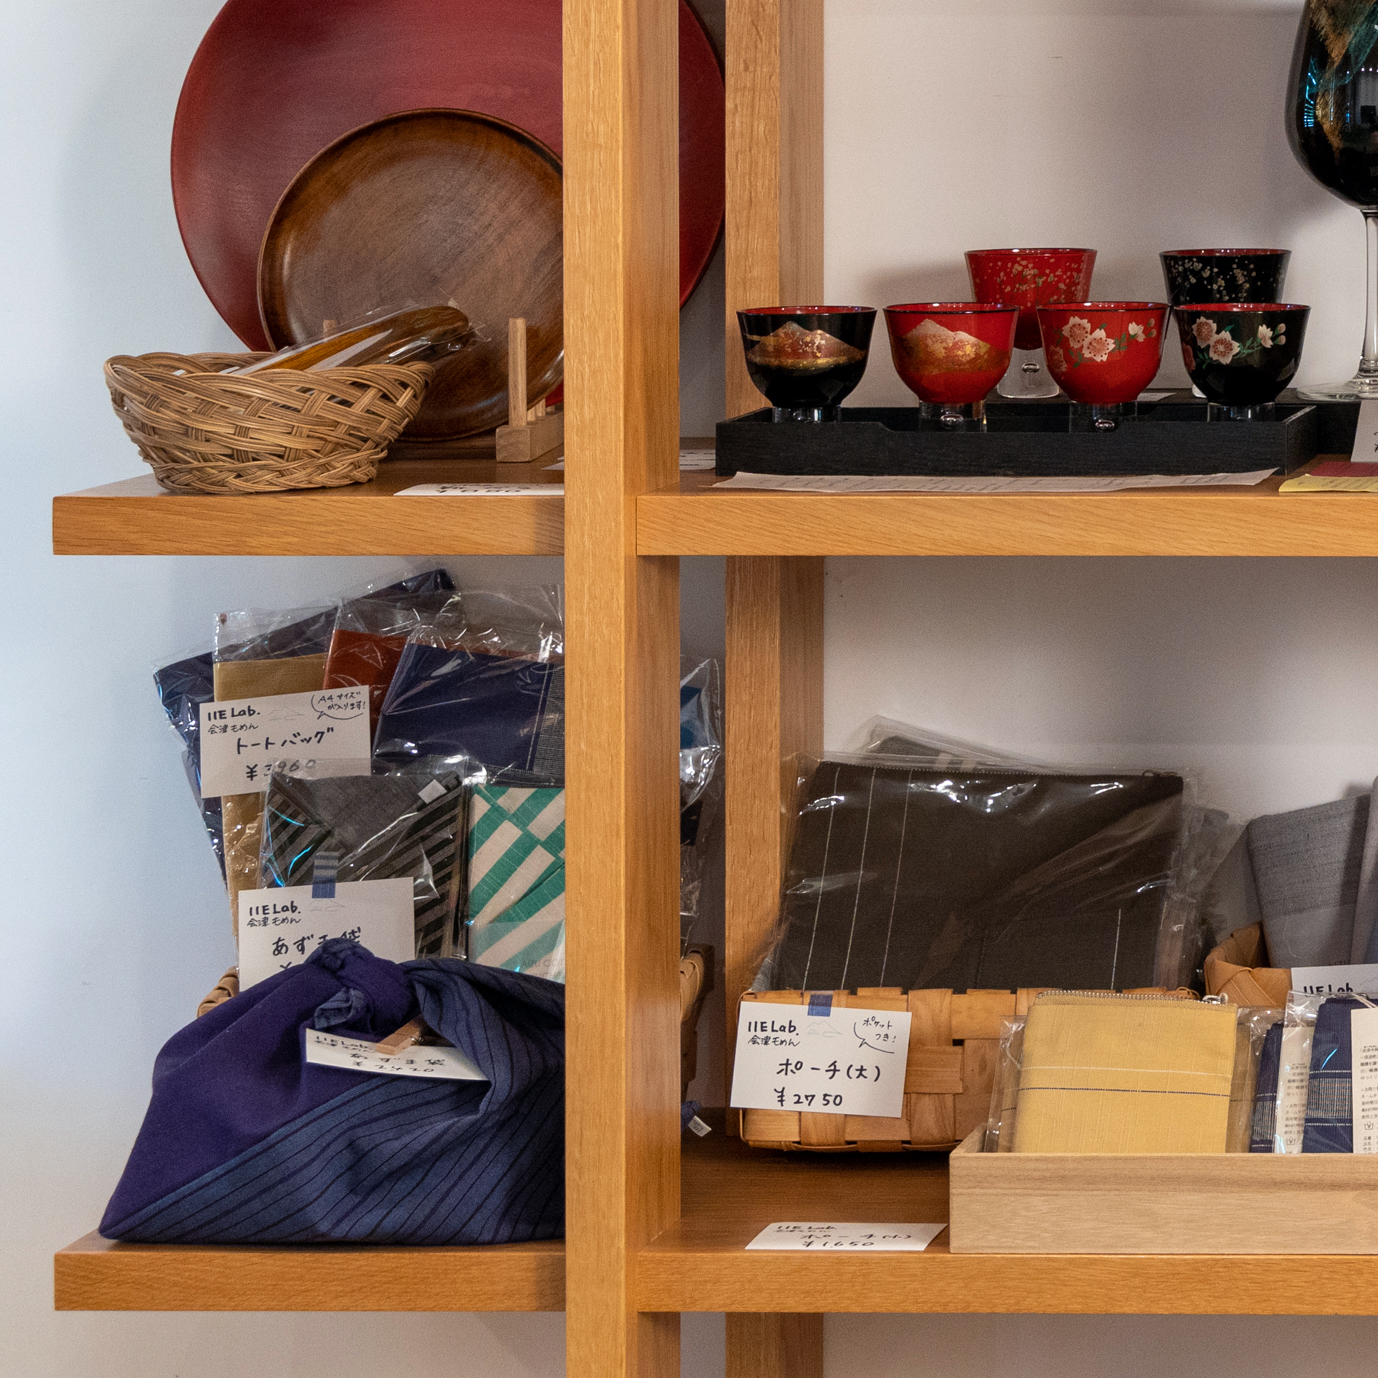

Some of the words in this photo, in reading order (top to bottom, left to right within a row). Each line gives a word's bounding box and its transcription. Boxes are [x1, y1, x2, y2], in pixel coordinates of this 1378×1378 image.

[237, 727, 334, 754] トートバッグ
[771, 1020, 800, 1036] Lab.
[862, 1016, 893, 1030] ポケット
